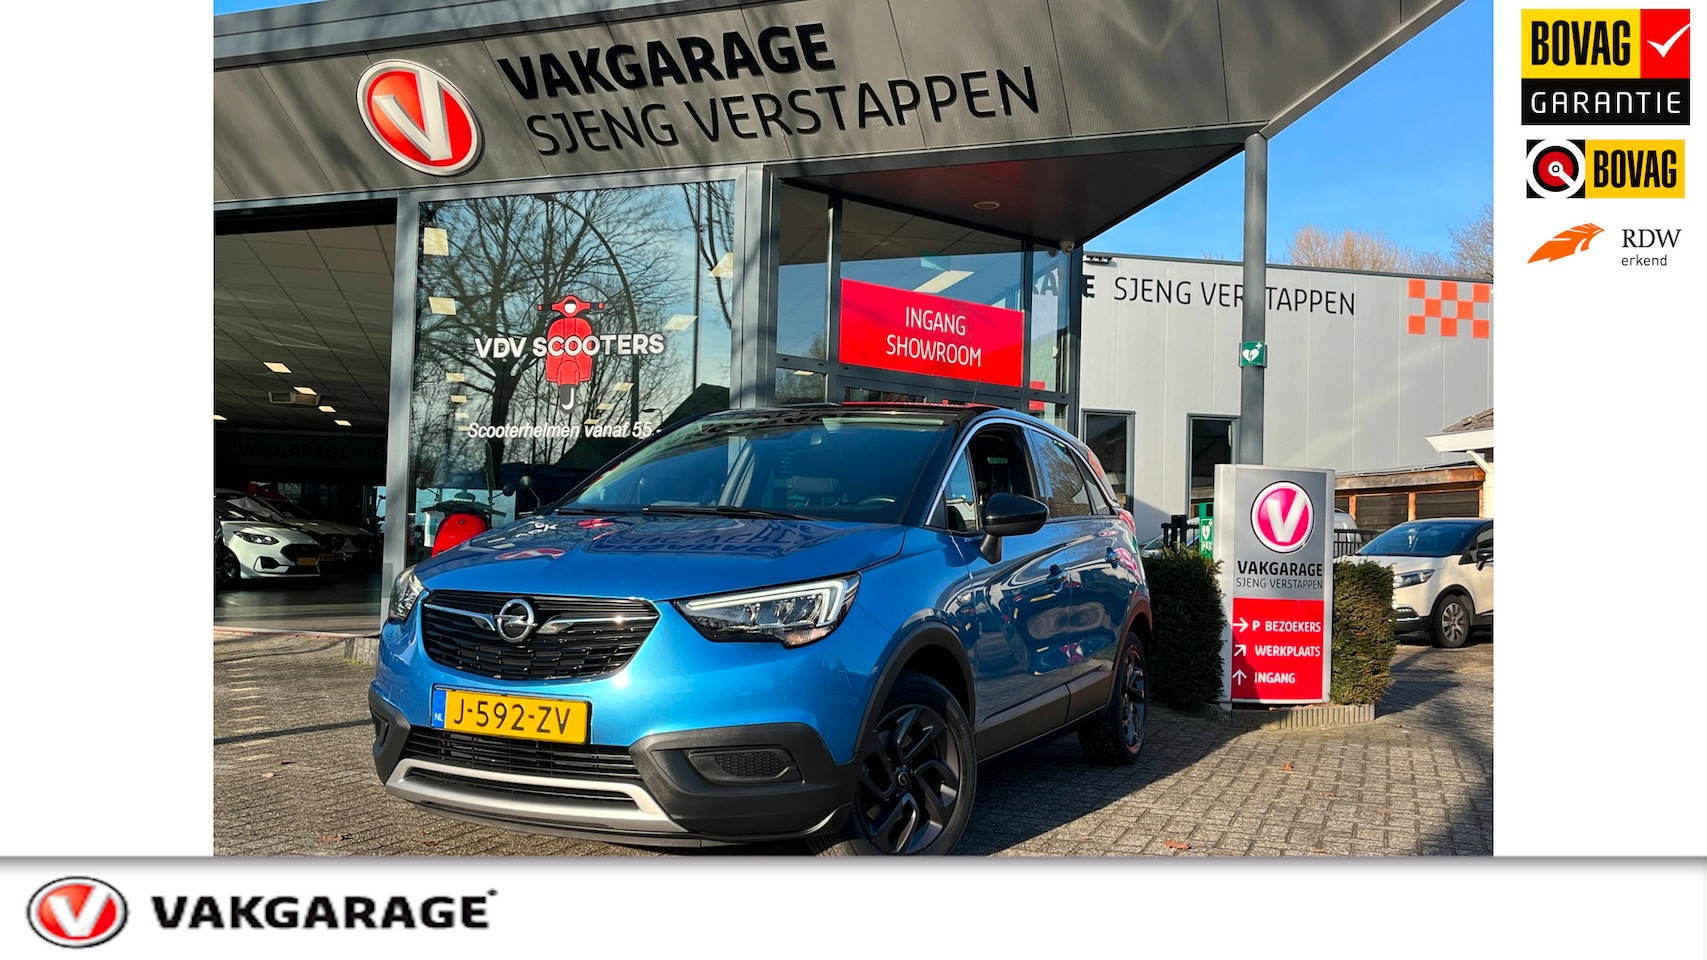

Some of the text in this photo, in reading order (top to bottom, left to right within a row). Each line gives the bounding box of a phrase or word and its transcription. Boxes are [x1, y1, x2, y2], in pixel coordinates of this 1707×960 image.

[497, 22, 837, 100] VAKGARAGE
[526, 65, 1040, 157] SJENG VERSTAPPEN
[1113, 276, 1192, 305] SJENG
[1200, 281, 1356, 316] VERTAPPEN
[905, 306, 967, 336] INGANG
[474, 332, 666, 359] VDV SCOOTERS
[885, 333, 982, 368] SHOWROOM
[467, 421, 580, 439] Scooterhelmen
[583, 421, 629, 439] vanaf
[1237, 560, 1323, 577] VAKGARAGE
[1235, 577, 1323, 590] SJENG VERSTAPPEN
[1251, 620, 1322, 633] P BEZOEKERS
[1254, 644, 1321, 658] WERKPLAATS
[1253, 671, 1296, 684] INGANG
[434, 698, 571, 735] NL J-592-ZV
